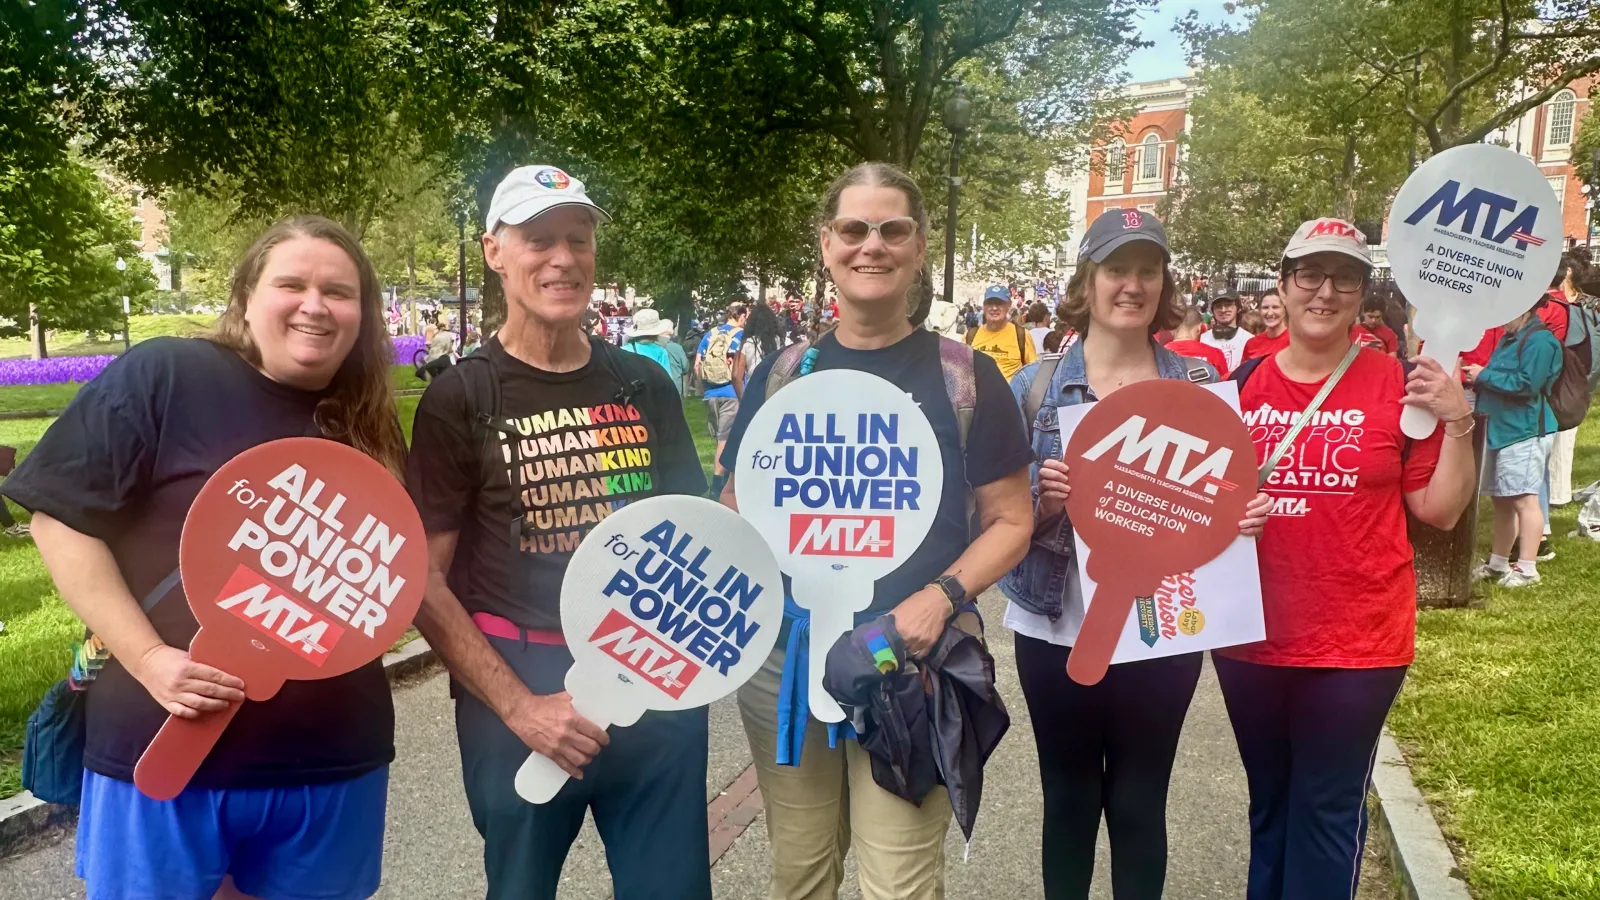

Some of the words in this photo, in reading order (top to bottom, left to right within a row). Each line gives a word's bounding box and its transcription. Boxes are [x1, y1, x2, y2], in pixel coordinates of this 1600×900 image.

[1304, 221, 1358, 241] MTA
[1404, 179, 1547, 251] MTA
[1422, 258, 1435, 269] of
[1436, 261, 1502, 289] EDUCATION
[1426, 243, 1434, 253] A
[1437, 246, 1485, 269] DIVERSE
[1486, 261, 1524, 281] UNION
[1419, 269, 1473, 294] WORKERS
[773, 413, 846, 444] ALL
[857, 413, 899, 445] IN
[1306, 426, 1364, 444] FOR
[752, 450, 783, 470] for
[784, 445, 919, 478] UNION
[1081, 414, 1239, 496] MTA
[774, 477, 921, 511] POWER
[1267, 471, 1358, 488] CATION
[267, 463, 347, 532] ALL
[351, 513, 406, 566] IN
[1094, 507, 1155, 537] WORKERS
[1099, 496, 1114, 508] of
[1115, 499, 1187, 534] EDUCATION
[1104, 480, 1114, 492] A
[1116, 484, 1169, 511] DIVERSE
[1170, 503, 1212, 527] UNION
[227, 478, 268, 510] for
[263, 494, 406, 608] UNION
[520, 529, 591, 553] HUM
[791, 518, 892, 554] MTA
[227, 518, 388, 639] POWER
[640, 519, 712, 582] ALL
[713, 564, 765, 612] IN
[604, 533, 640, 561] for
[635, 547, 761, 650] UNION
[1178, 570, 1197, 610] ter
[216, 582, 329, 654] MTA
[602, 568, 741, 677] POWER
[592, 625, 686, 689] MTA
